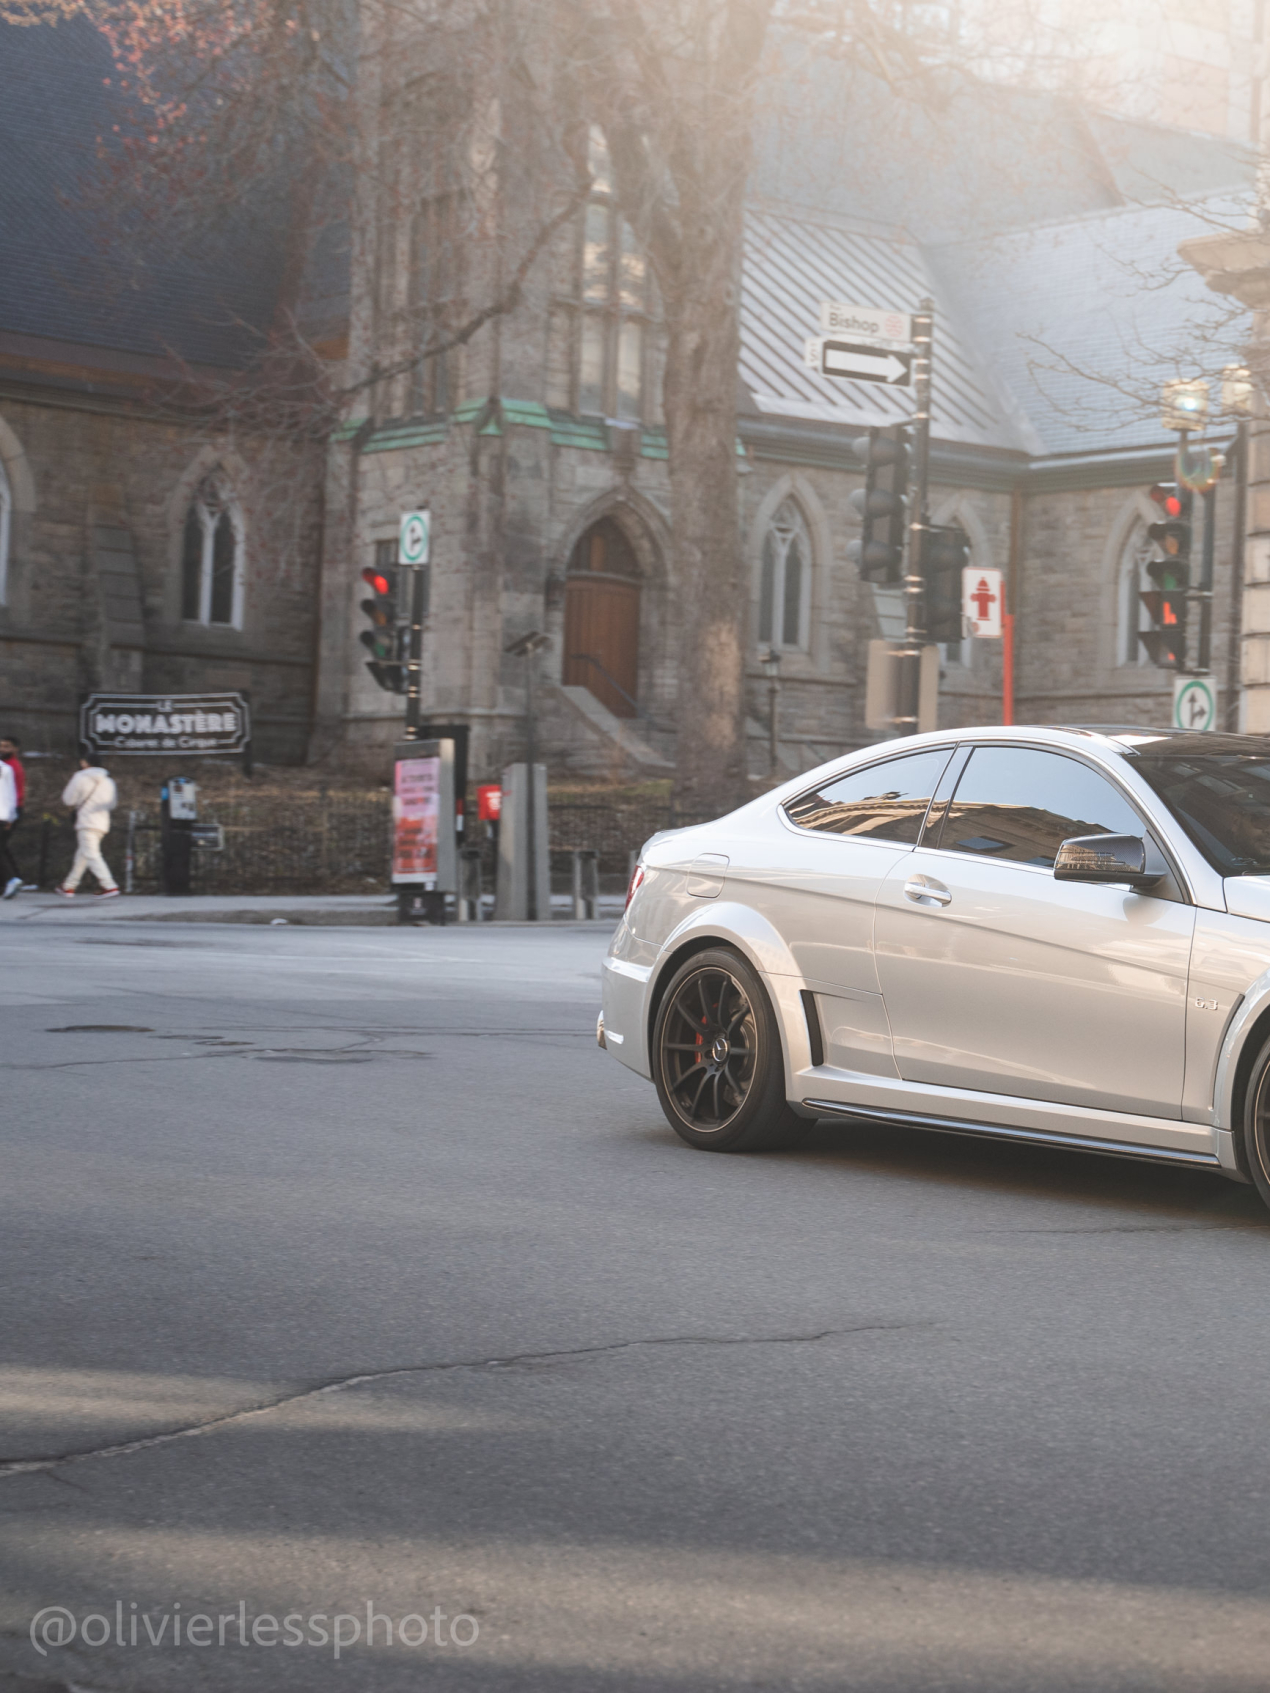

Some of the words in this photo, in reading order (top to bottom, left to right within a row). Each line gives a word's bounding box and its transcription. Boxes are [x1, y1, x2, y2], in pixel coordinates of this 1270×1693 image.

[828, 312, 880, 334] Bishop
[156, 699, 174, 713] LE
[95, 709, 237, 735] MONASTÈRE
[1195, 997, 1219, 1011] 6.3
